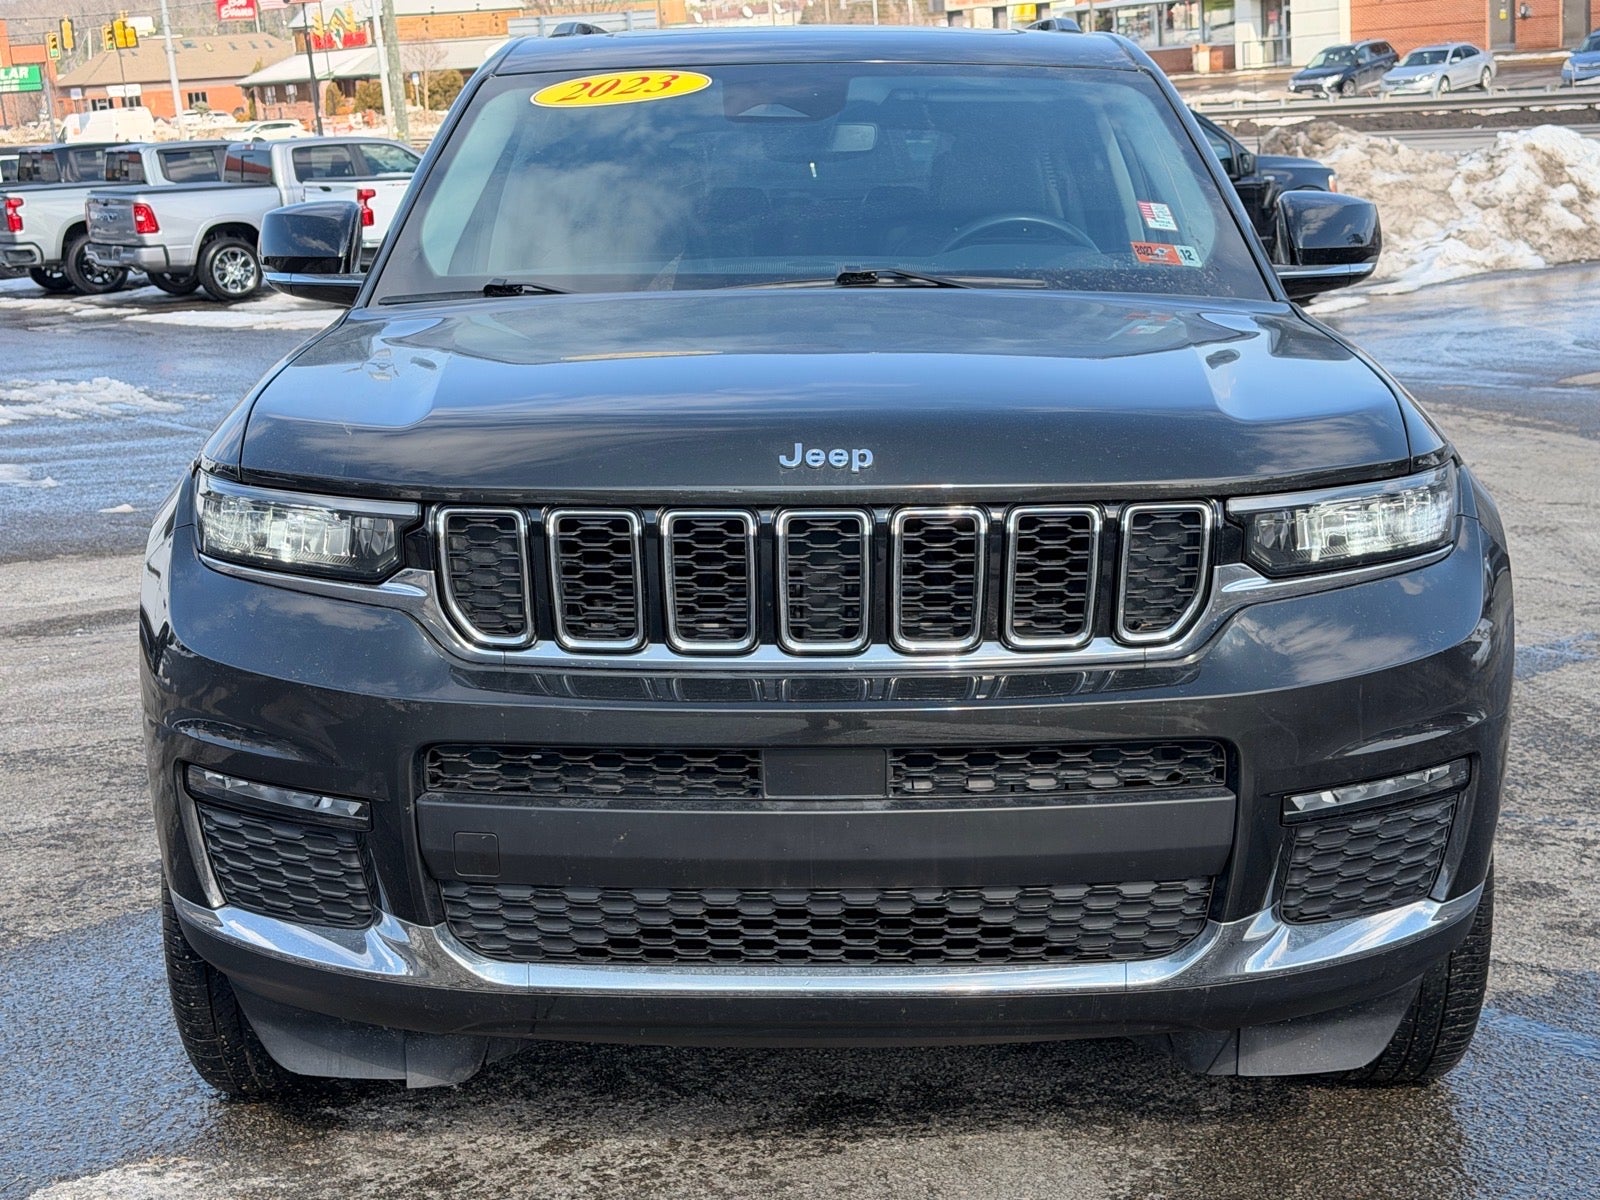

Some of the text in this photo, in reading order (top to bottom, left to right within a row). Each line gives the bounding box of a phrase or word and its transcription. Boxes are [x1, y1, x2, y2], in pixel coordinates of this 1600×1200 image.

[553, 75, 680, 103] 2023
[1179, 249, 1195, 261] 12
[779, 443, 874, 473] Jeep
